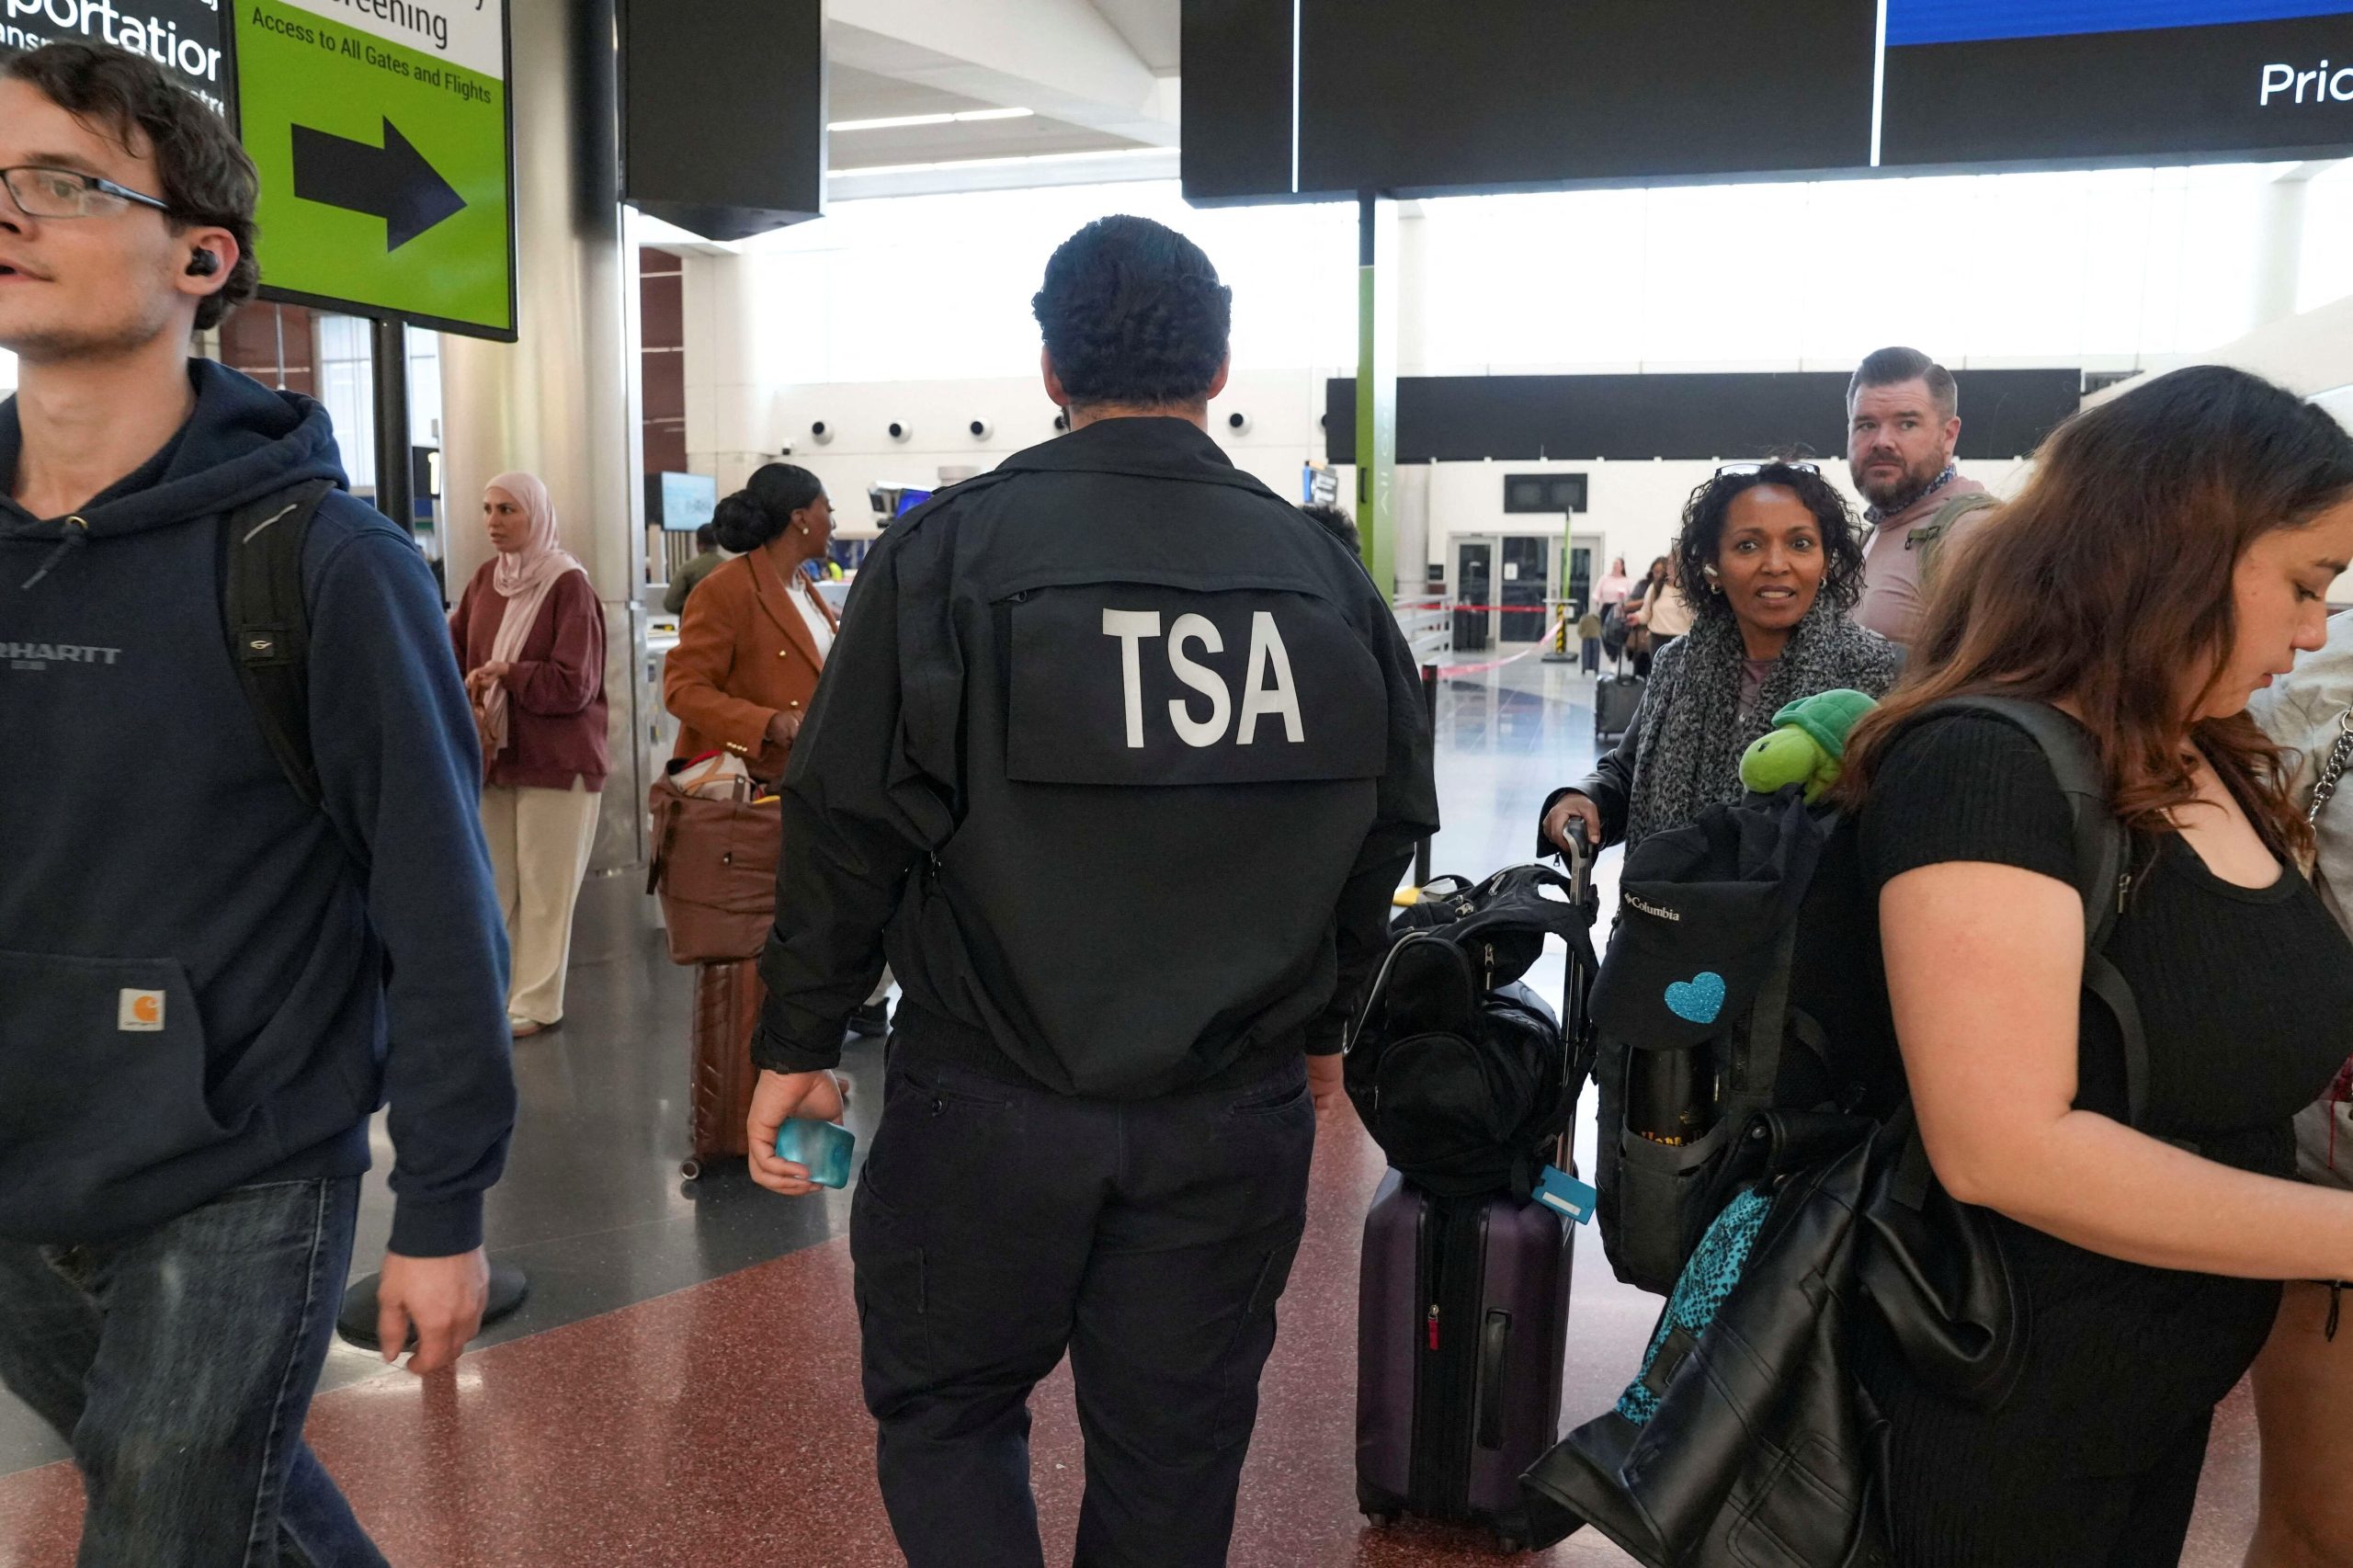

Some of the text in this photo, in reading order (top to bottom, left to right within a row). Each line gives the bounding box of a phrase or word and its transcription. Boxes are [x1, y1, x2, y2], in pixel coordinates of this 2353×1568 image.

[252, 6, 491, 104] Access to All Gates and Flights
[332, 0, 448, 50] ening
[1103, 608, 1305, 748] TSA
[1631, 896, 1680, 921] Columbia
